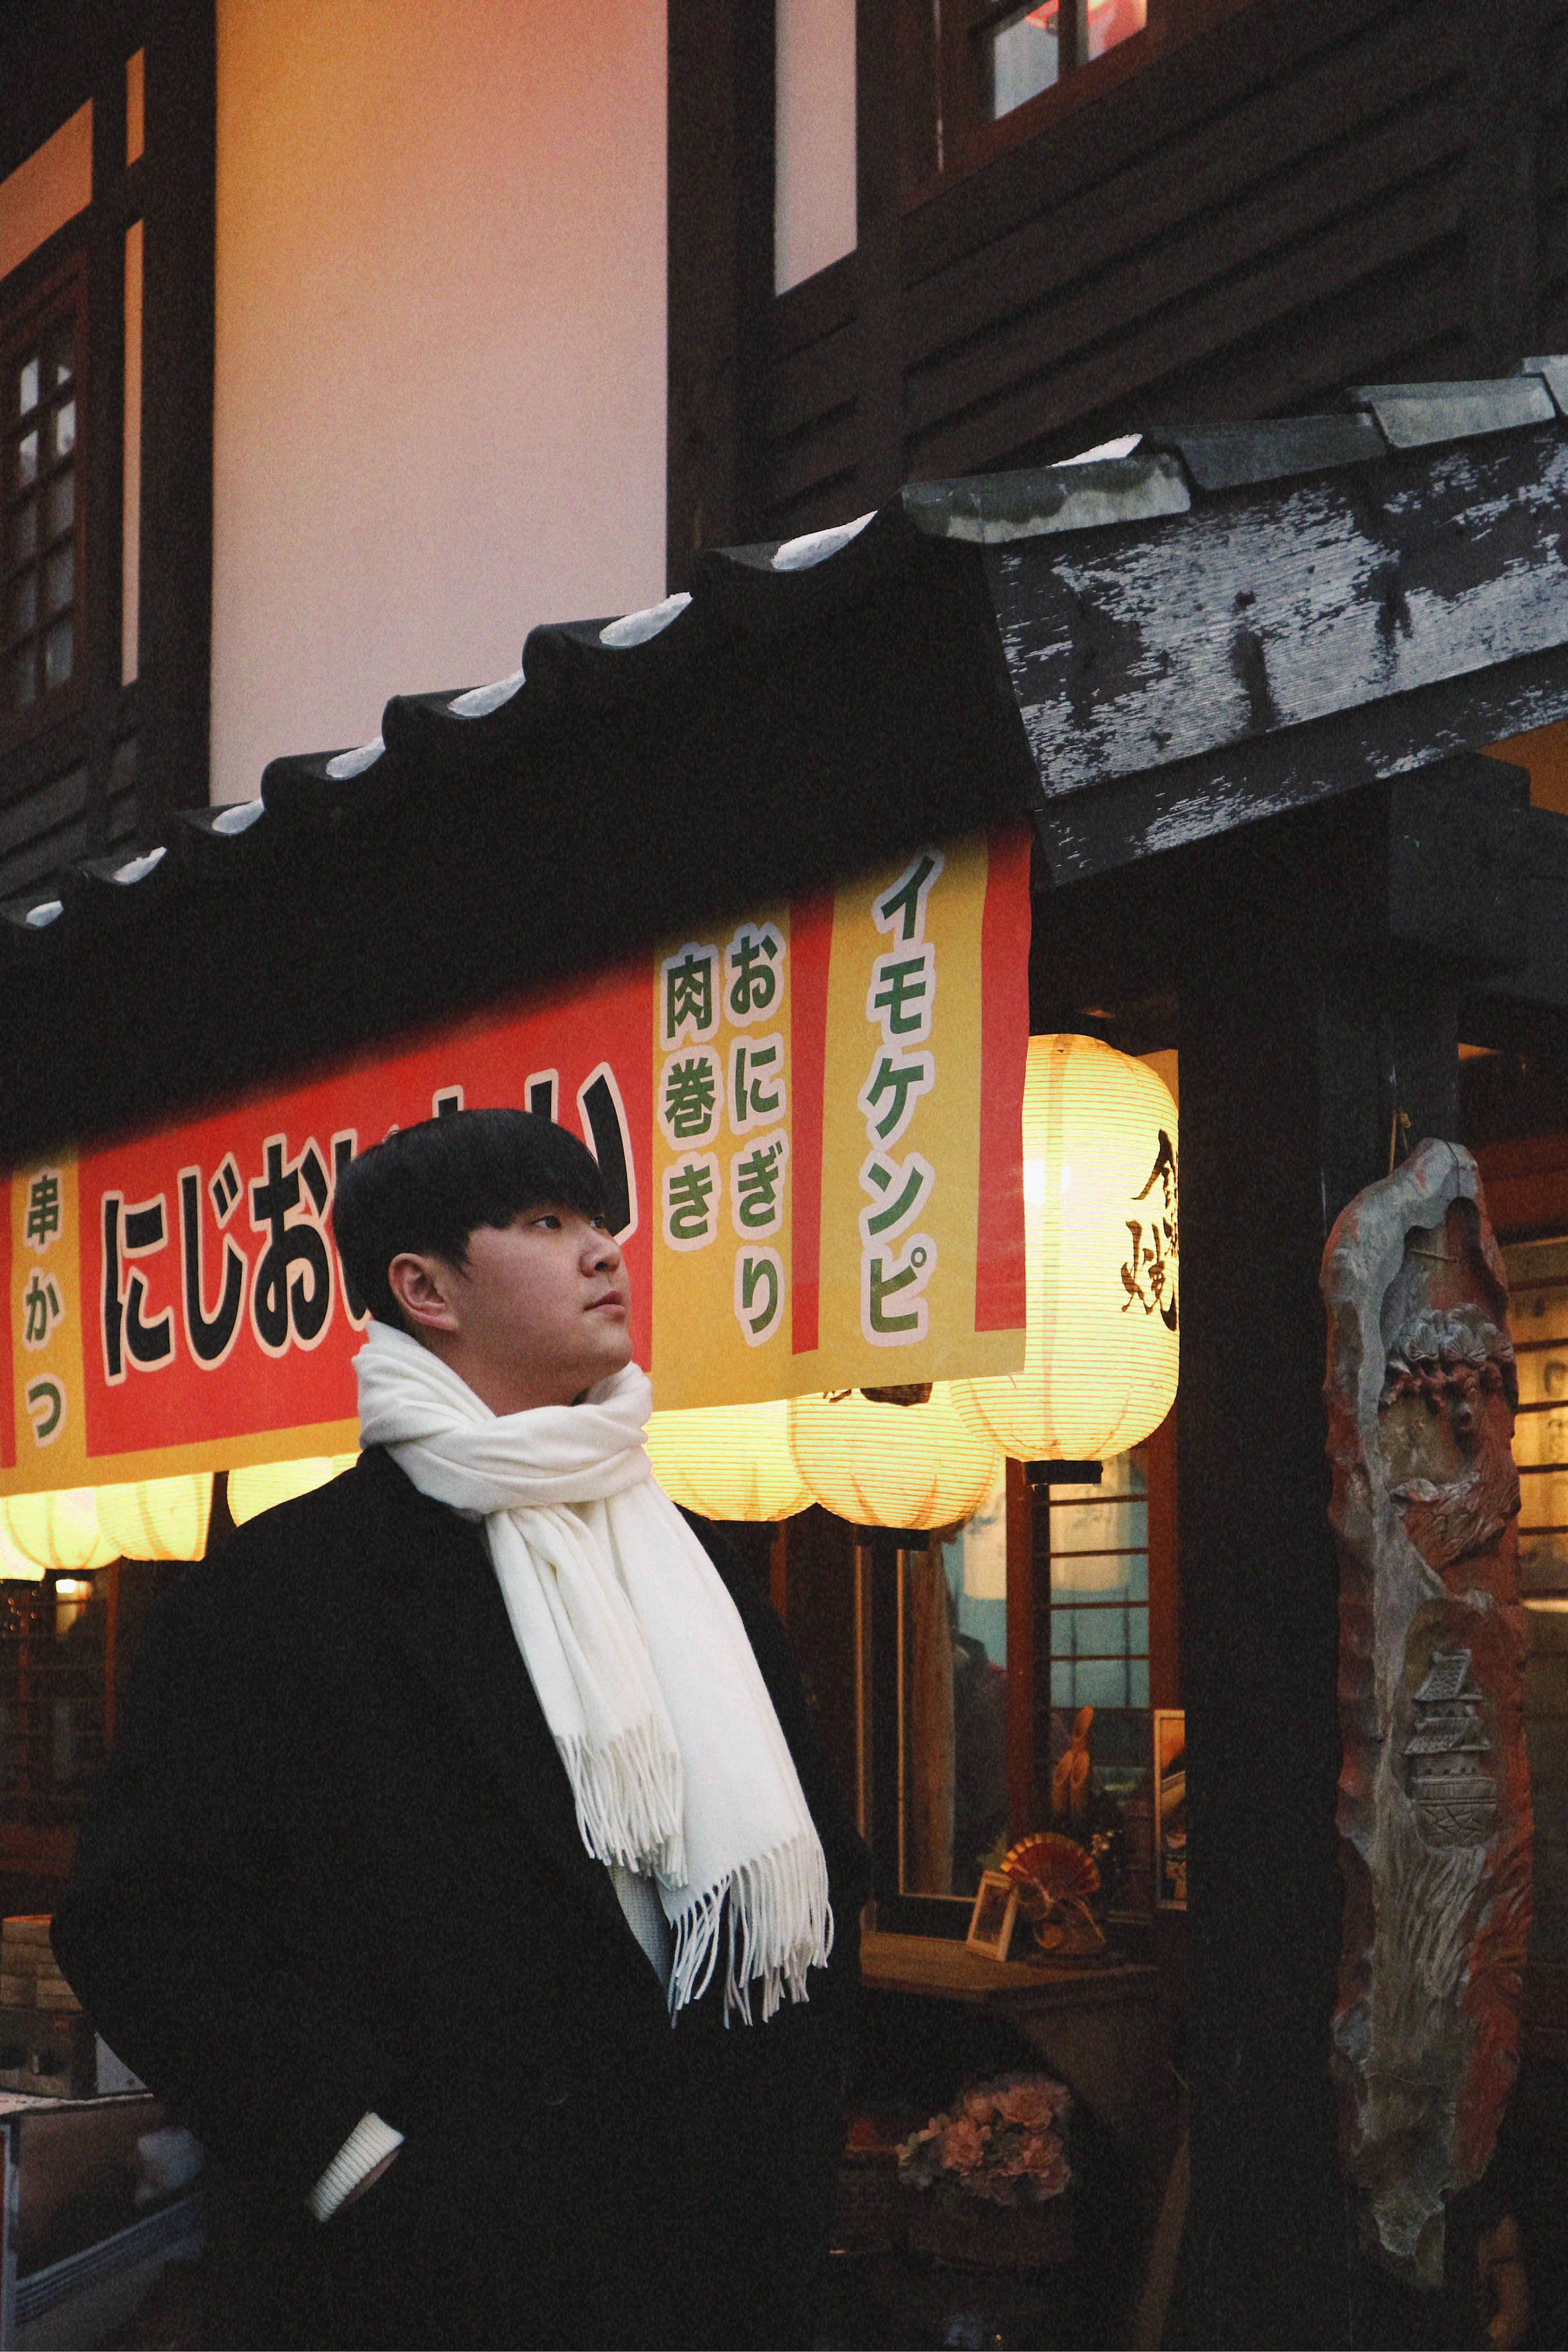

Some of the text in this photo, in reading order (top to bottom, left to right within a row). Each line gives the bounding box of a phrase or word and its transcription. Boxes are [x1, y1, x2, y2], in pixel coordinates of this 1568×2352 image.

[104, 1071, 632, 1378] にじおい
[663, 953, 717, 1241] 肉巻き
[728, 933, 785, 1336] おにぎり
[864, 853, 937, 1335] イモケンピ
[26, 1174, 62, 1440] 串かつ
